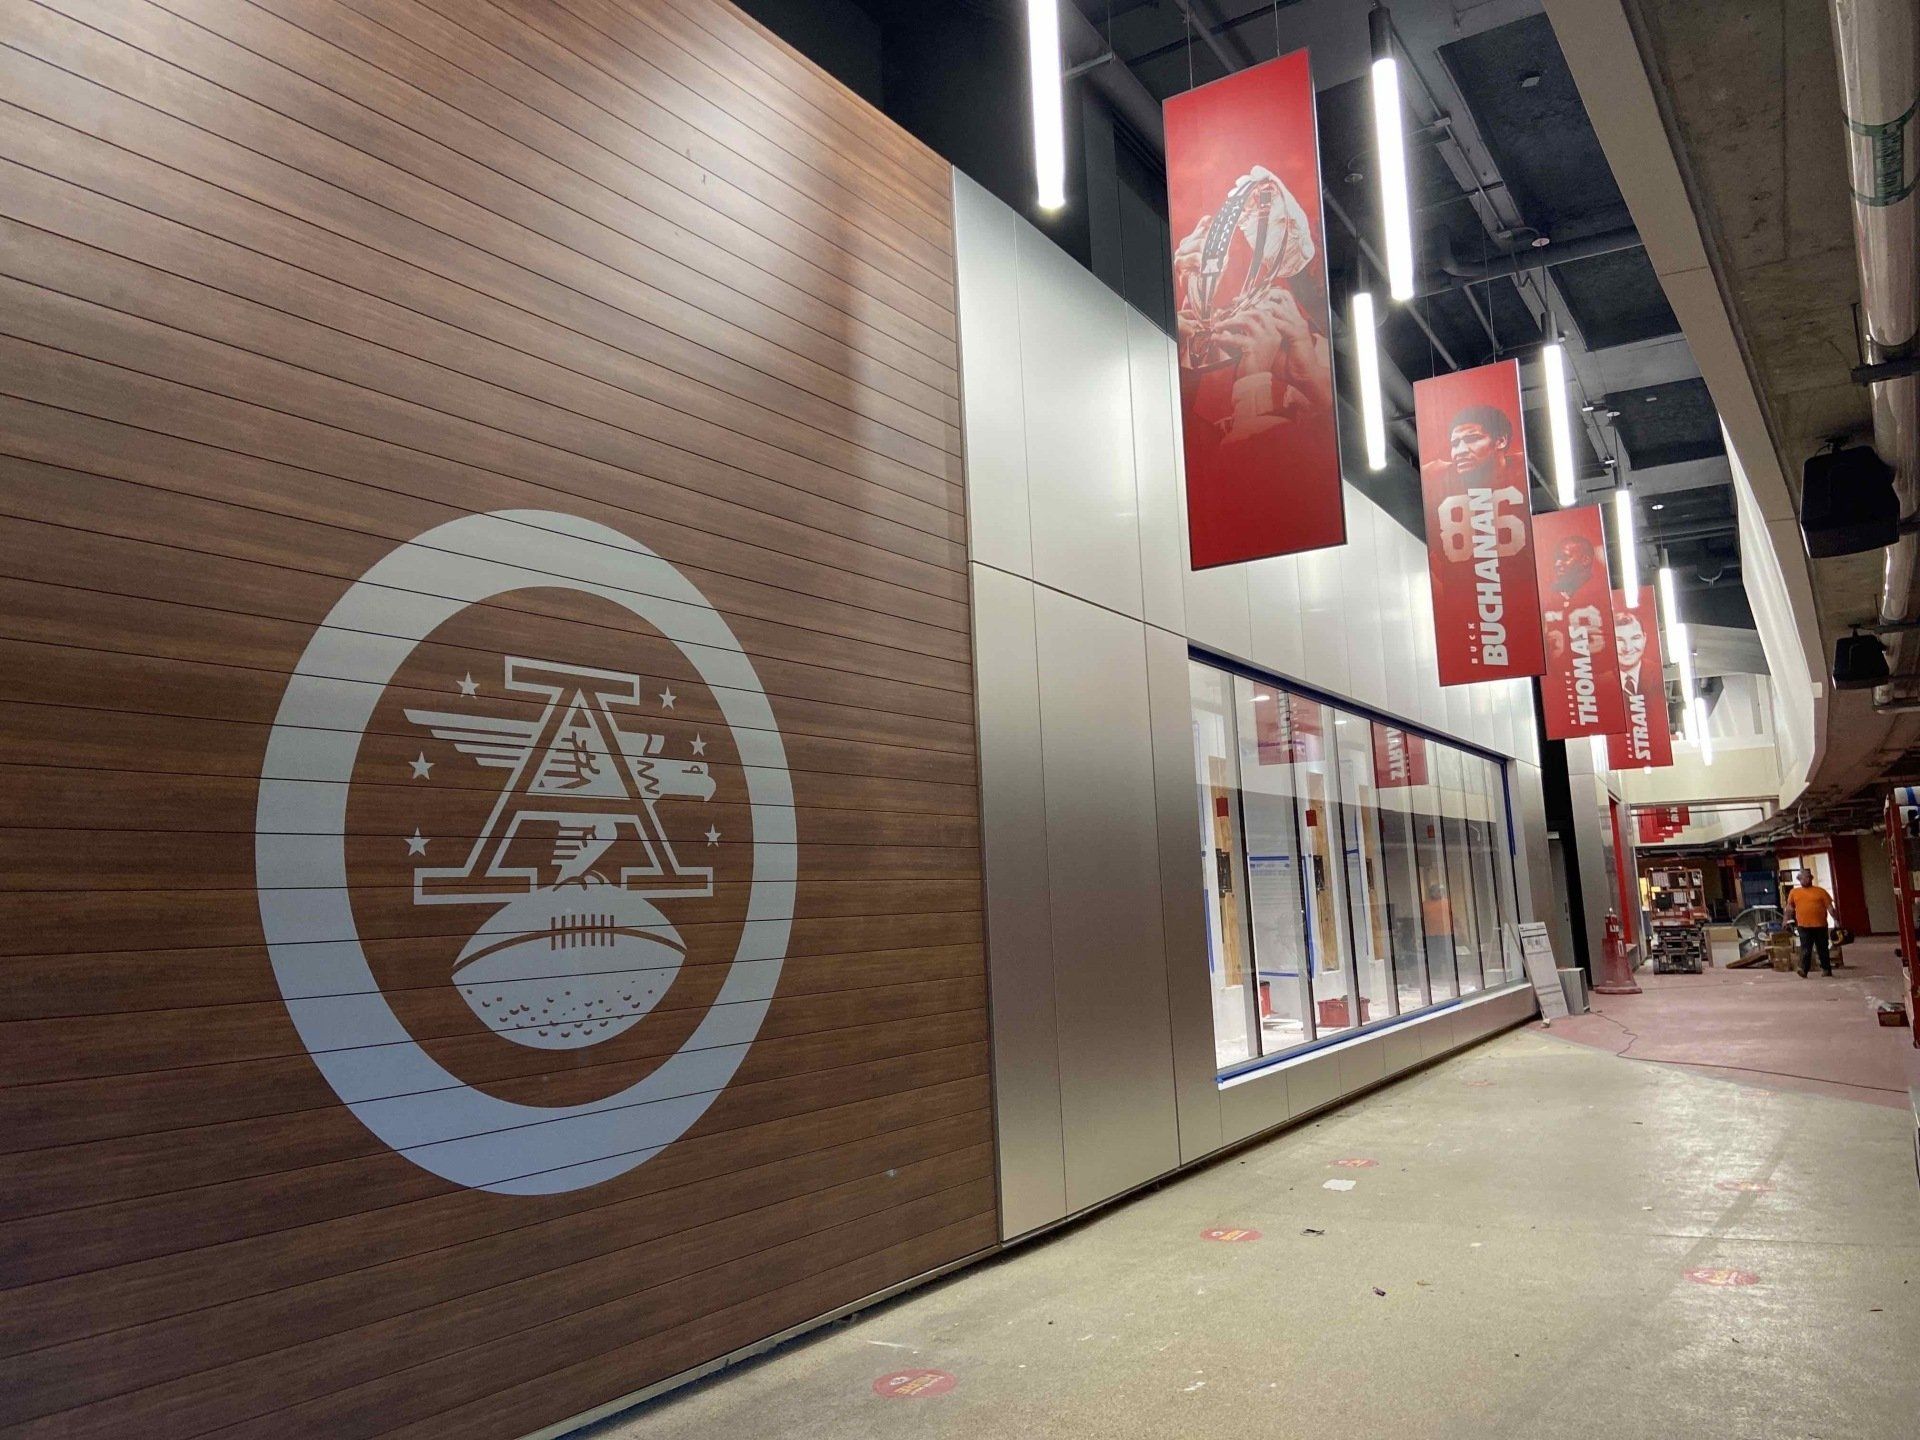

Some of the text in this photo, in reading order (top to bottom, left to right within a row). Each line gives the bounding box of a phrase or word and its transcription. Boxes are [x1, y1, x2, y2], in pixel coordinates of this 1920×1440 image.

[1468, 488, 1509, 666] BUCHANAN
[1467, 623, 1479, 665] BUCK
[1568, 626, 1599, 725] THOMAS
[1628, 694, 1651, 760] STRAM
